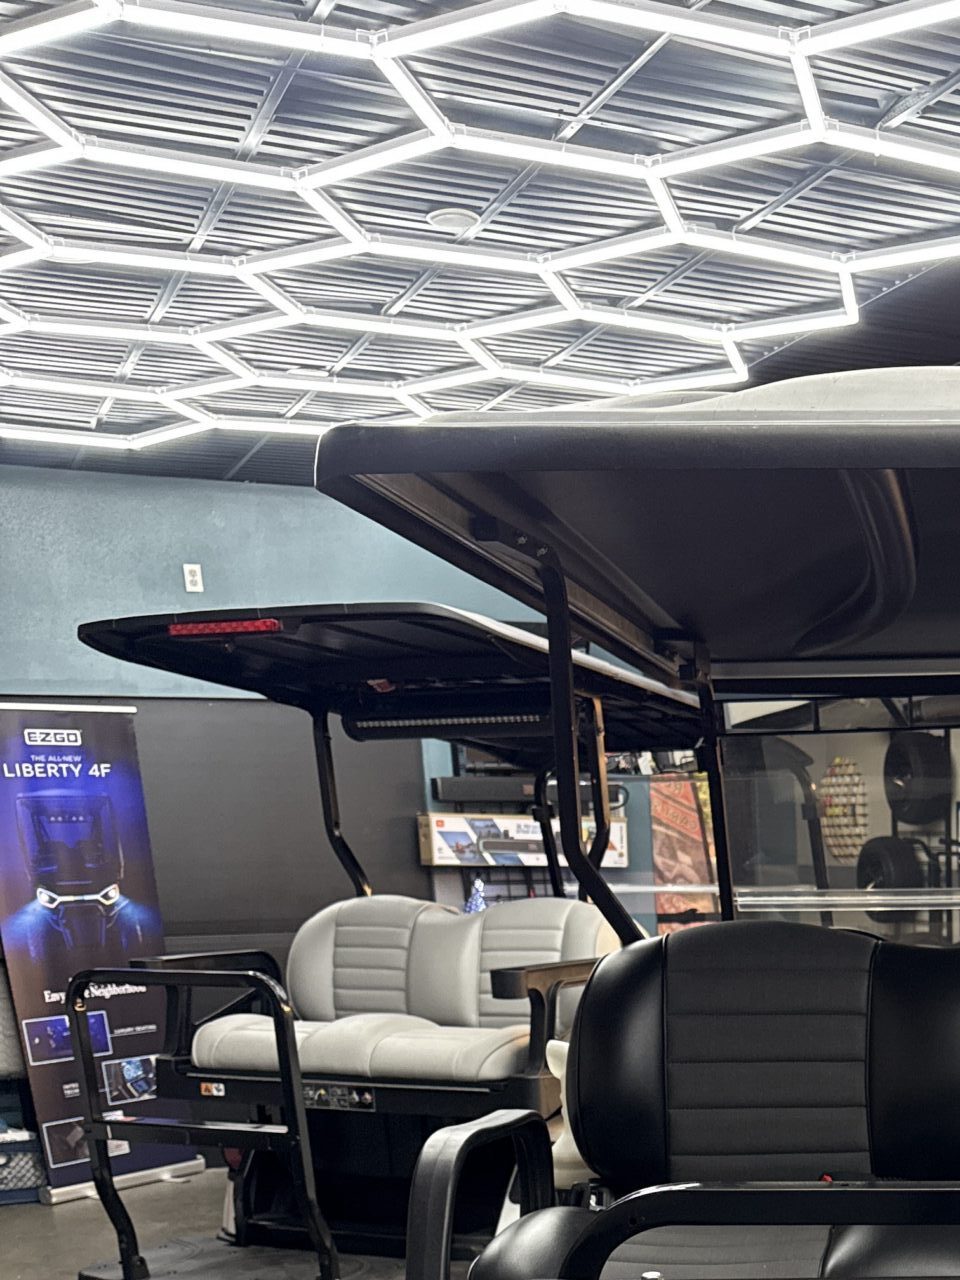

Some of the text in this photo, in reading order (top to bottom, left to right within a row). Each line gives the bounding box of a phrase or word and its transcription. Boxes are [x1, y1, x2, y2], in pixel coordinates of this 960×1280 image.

[26, 730, 80, 744] EZGO
[31, 754, 46, 762] THE
[3, 762, 111, 778] LIBERTY 4F
[43, 990, 66, 1004] Envy
